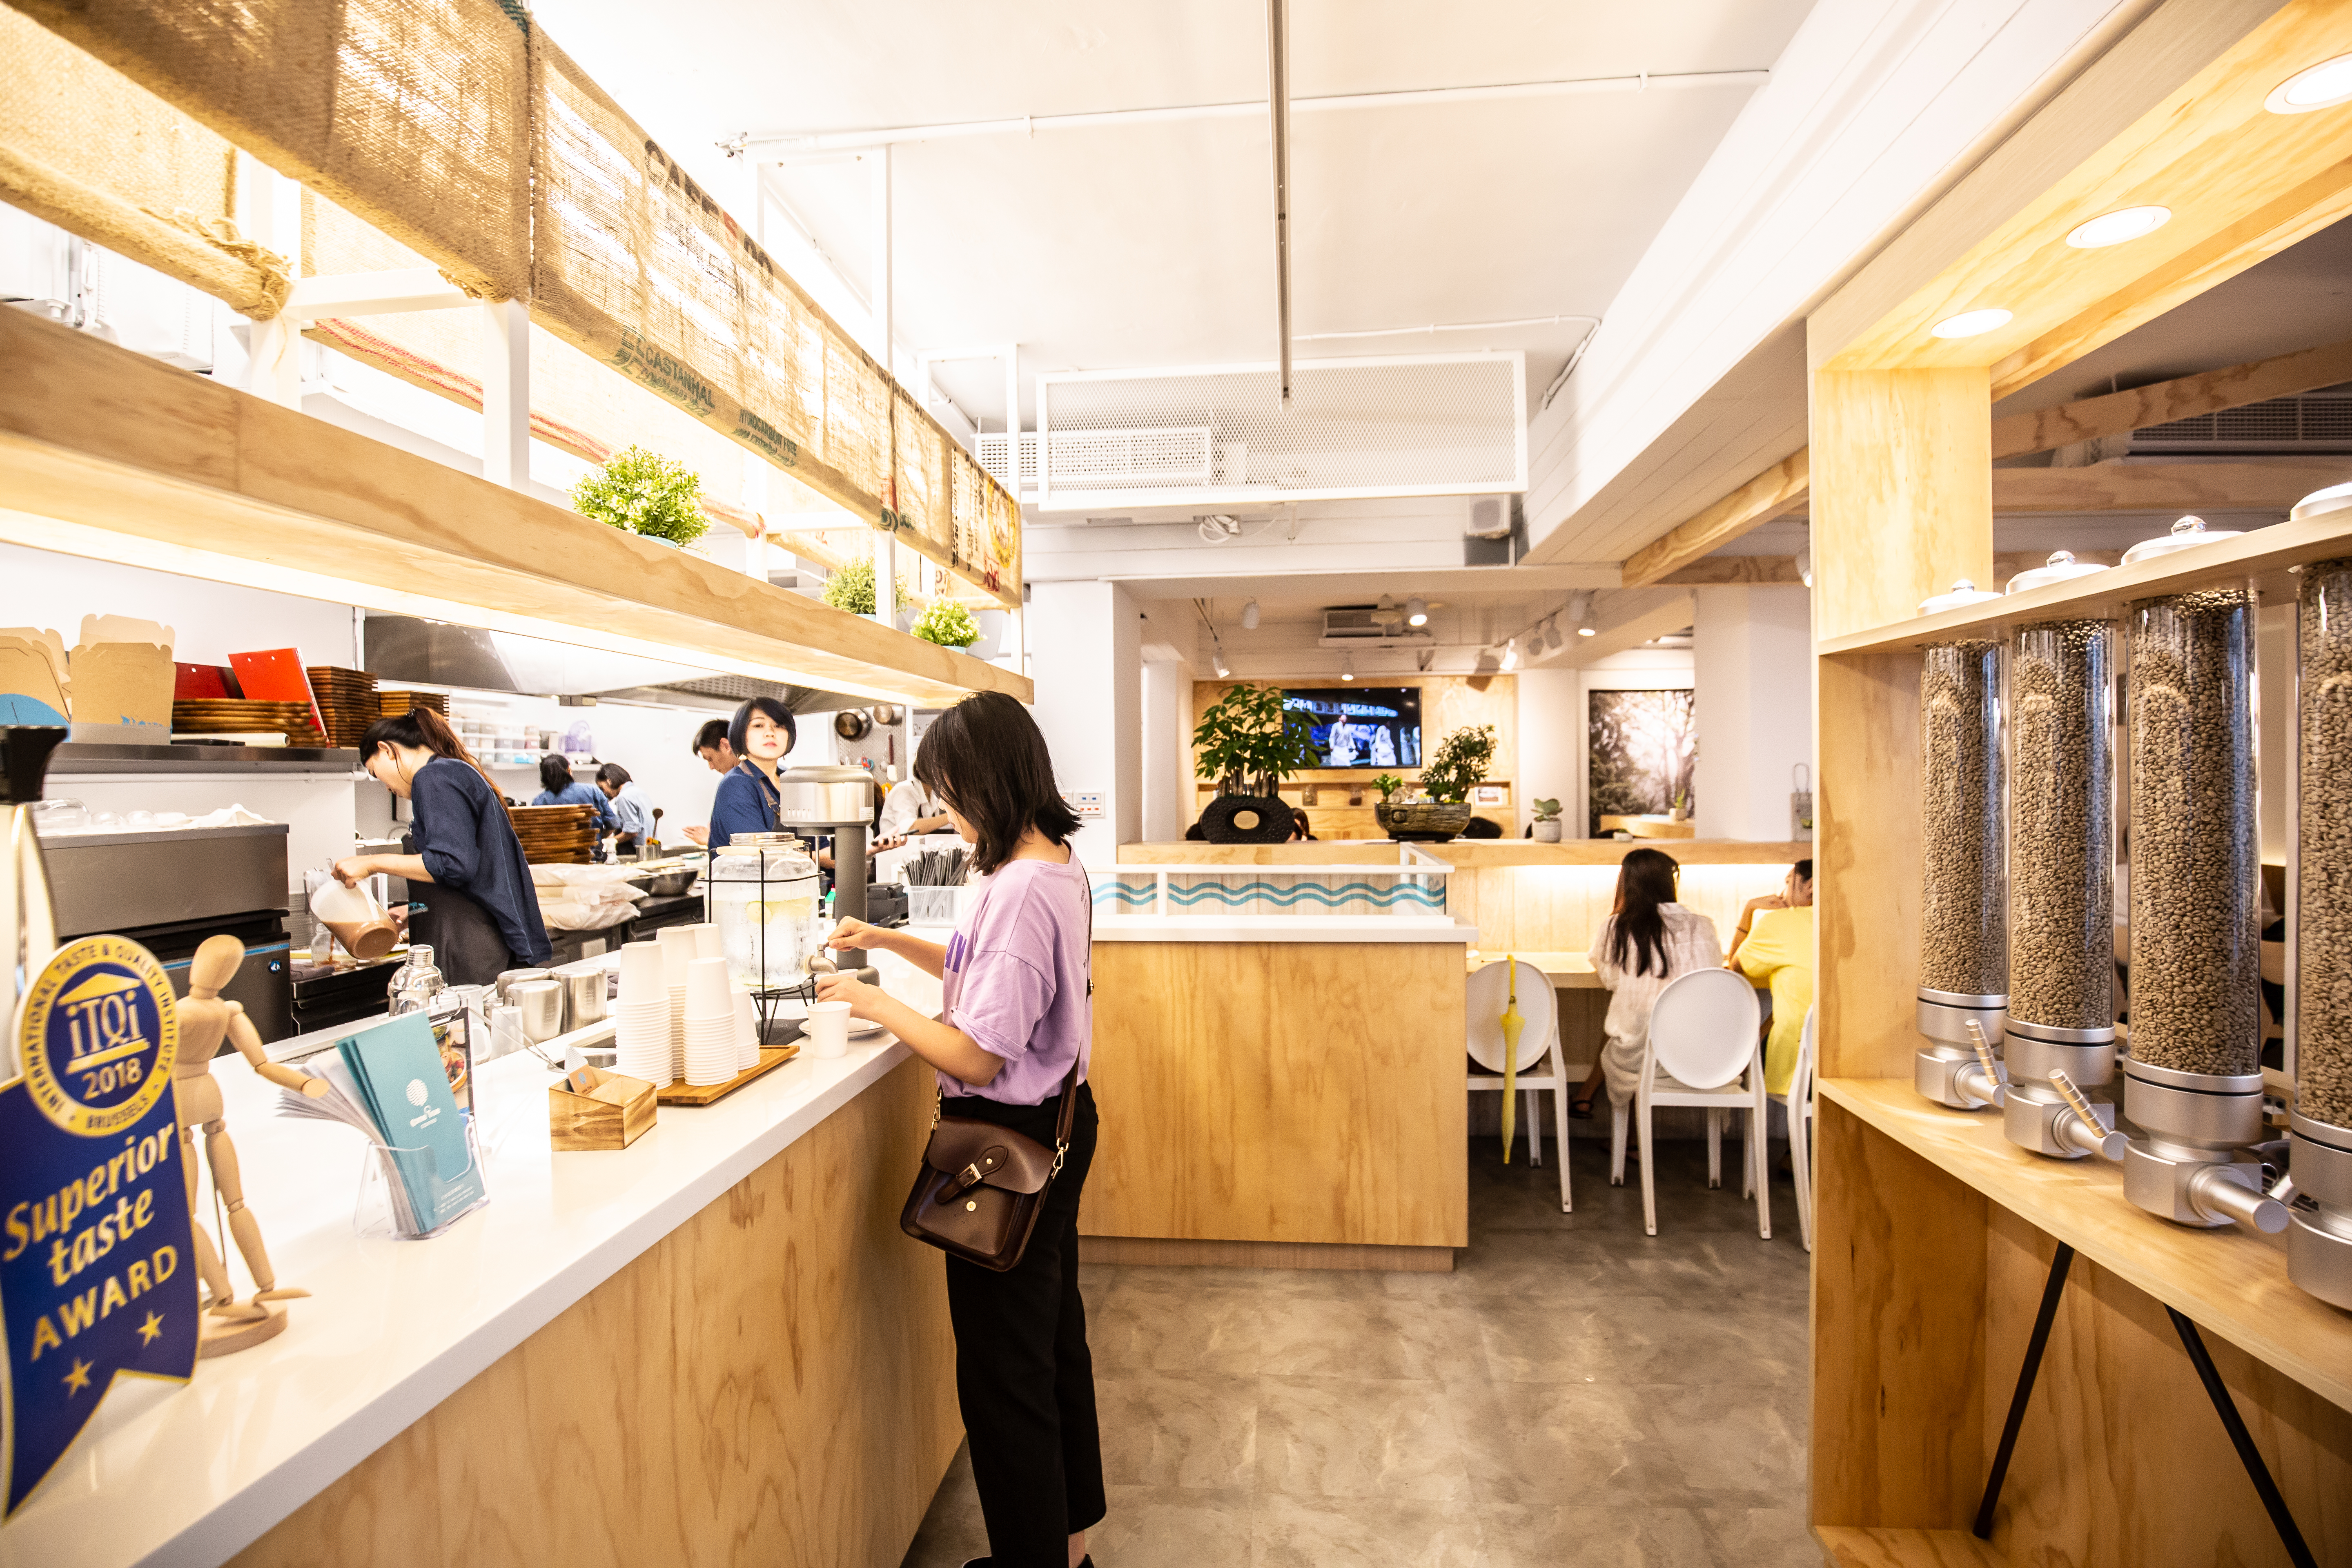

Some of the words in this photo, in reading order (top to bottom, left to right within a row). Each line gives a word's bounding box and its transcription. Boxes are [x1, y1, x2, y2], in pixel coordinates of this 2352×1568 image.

[646, 346, 715, 409] CASTANHAL
[27, 978, 63, 1113] INTERNATIONAL
[55, 943, 98, 976] TASTE
[115, 944, 163, 989] QUALITY
[158, 991, 176, 1074] INSTITUTE
[82, 1057, 143, 1101] 2018
[85, 1093, 150, 1130] BRUSSELS
[3, 1121, 175, 1262] Superior
[47, 1188, 156, 1287] taste
[31, 1244, 179, 1363] AWARD
